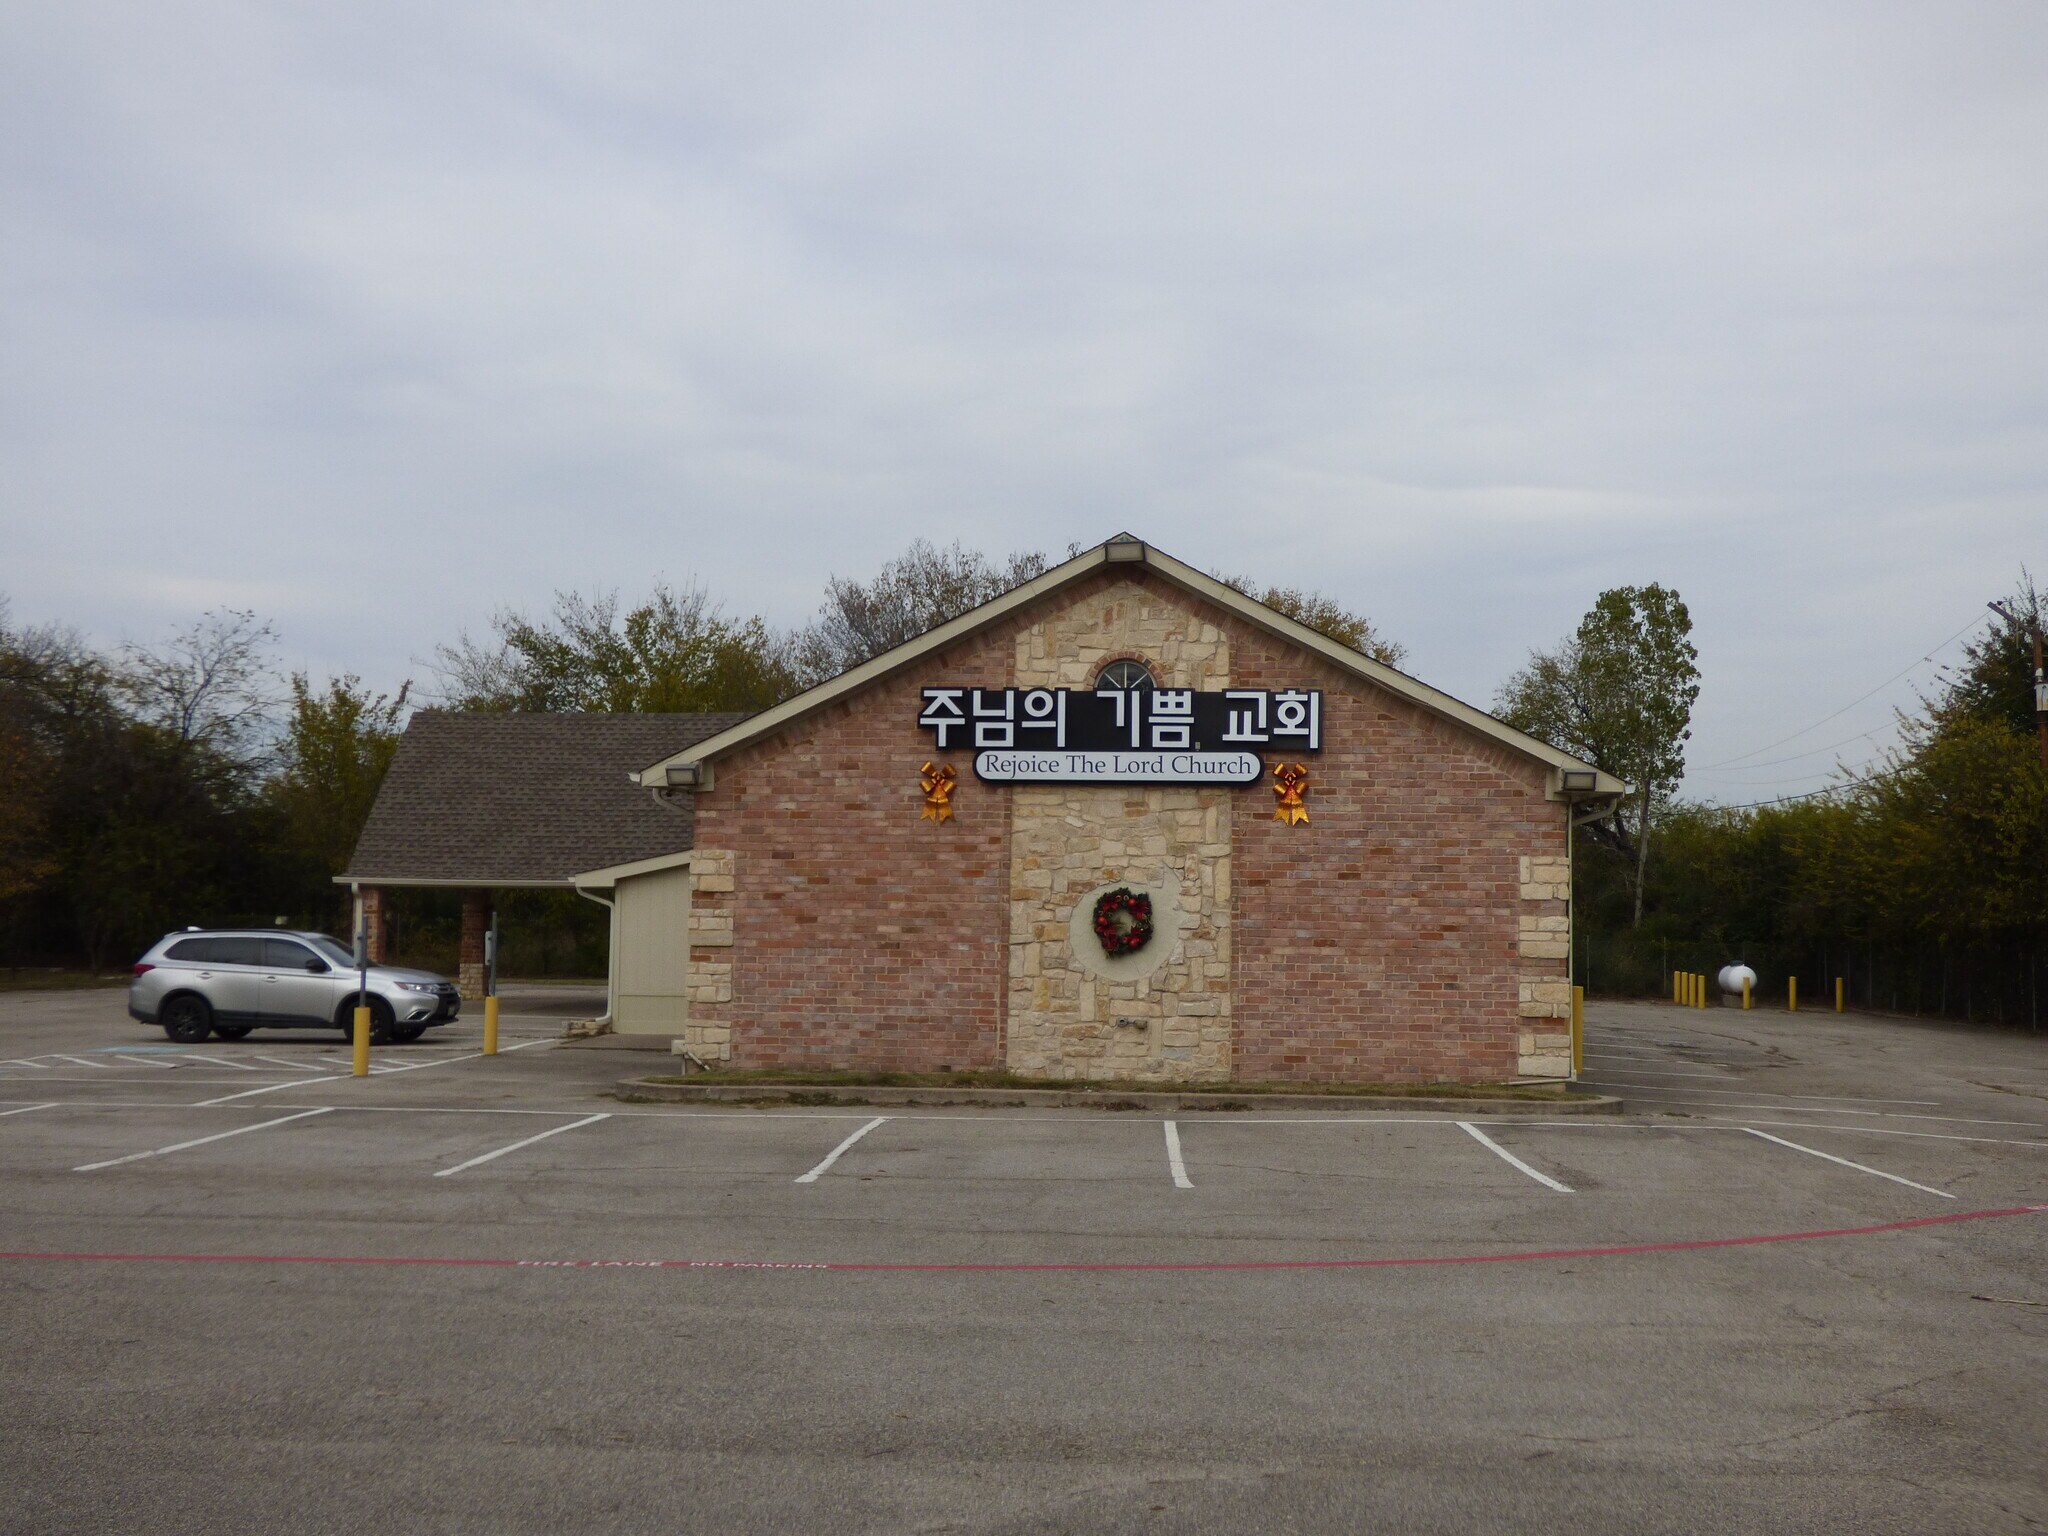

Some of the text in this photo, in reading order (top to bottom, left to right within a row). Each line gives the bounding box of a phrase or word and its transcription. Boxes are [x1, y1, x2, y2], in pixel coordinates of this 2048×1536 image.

[919, 689, 1319, 749] 주님의 기쁨 교회
[984, 754, 1252, 779] Rejoice The Lord Church
